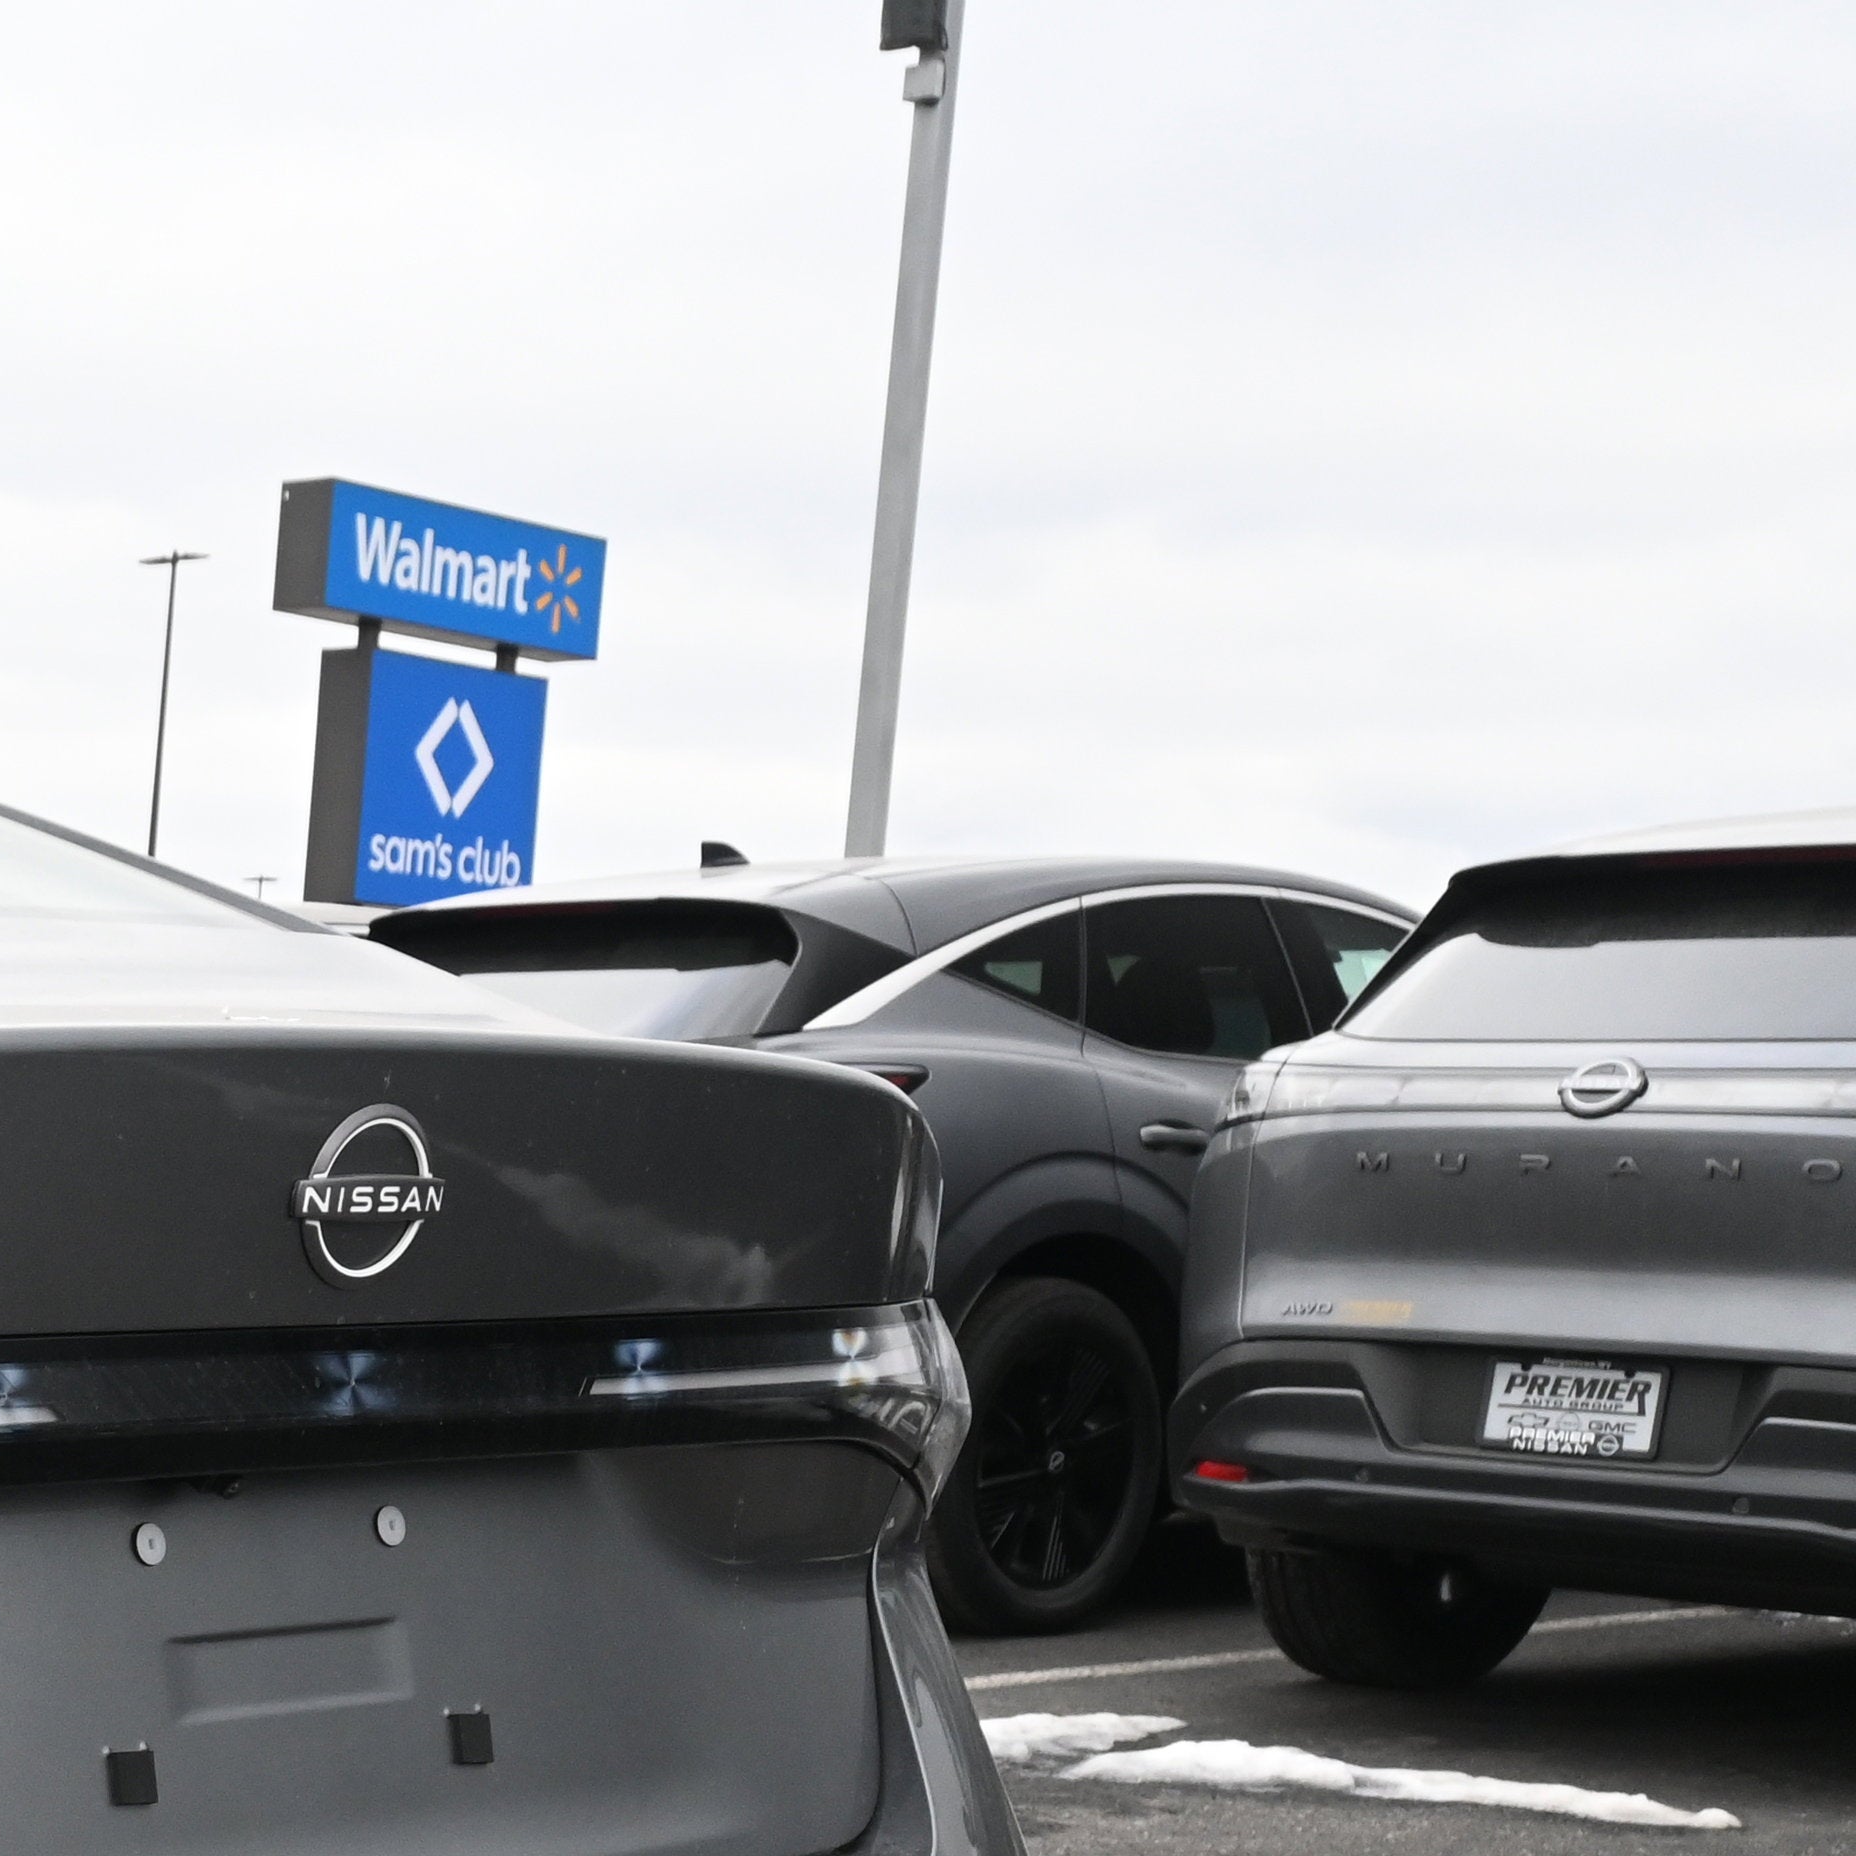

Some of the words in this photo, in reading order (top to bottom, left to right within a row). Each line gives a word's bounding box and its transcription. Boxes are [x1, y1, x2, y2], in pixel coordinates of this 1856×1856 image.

[355, 512, 531, 615] Walmart
[368, 832, 454, 881] sam's
[456, 835, 520, 886] club
[1356, 1151, 1844, 1182] MURANO
[302, 1185, 445, 1213] NISSAN
[1504, 1372, 1652, 1416] PREMIER
[1522, 1397, 1563, 1407] AUTO
[1568, 1400, 1624, 1411] GROUP
[1509, 1426, 1595, 1445] PREMIER
[1588, 1420, 1637, 1433] GMC
[1512, 1438, 1588, 1455] NISSAN
